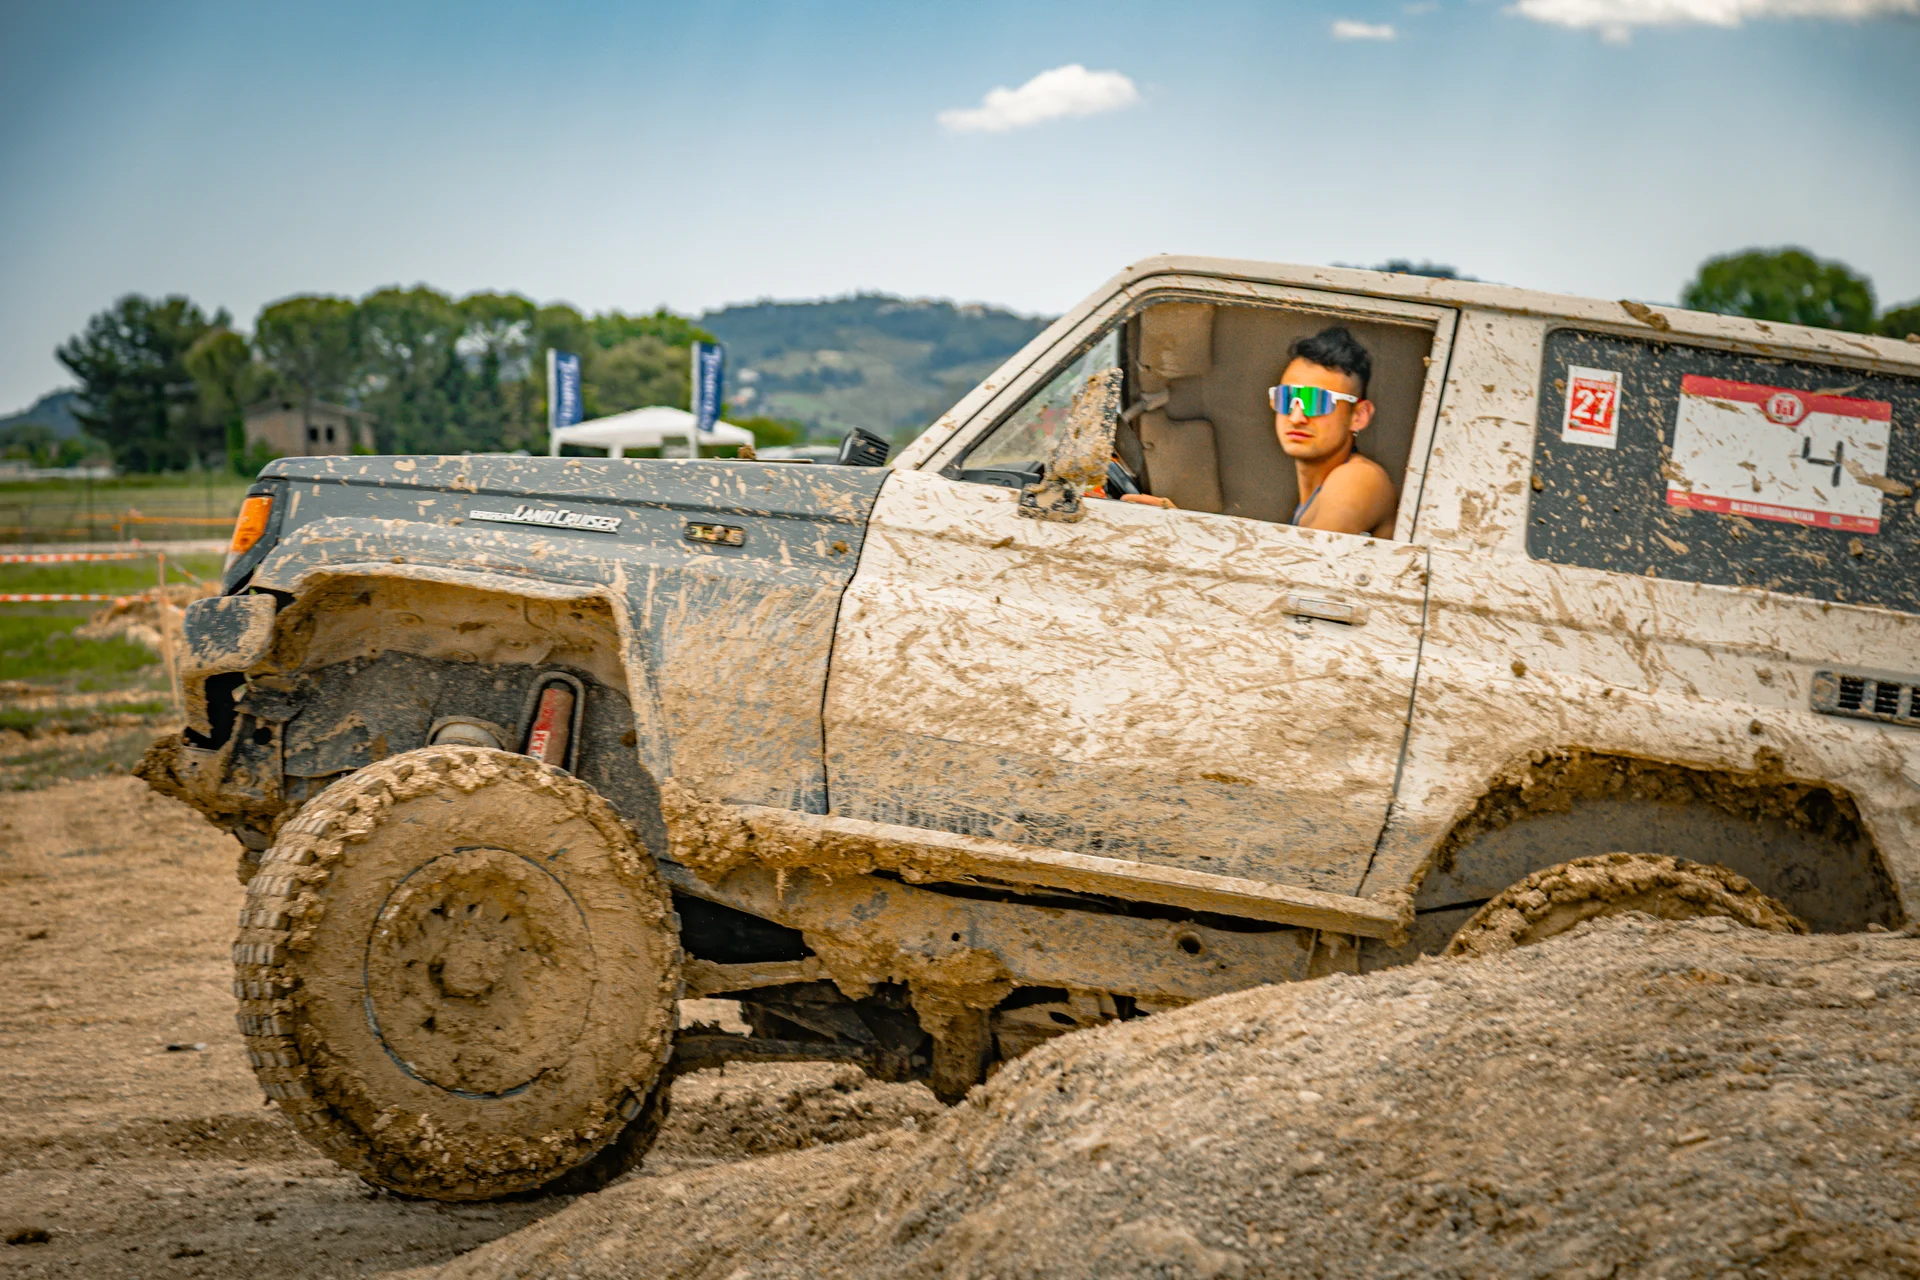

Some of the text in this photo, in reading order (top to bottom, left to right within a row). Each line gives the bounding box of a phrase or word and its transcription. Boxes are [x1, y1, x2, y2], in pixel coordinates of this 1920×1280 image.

[1571, 389, 1613, 423] 27
[1801, 436, 1844, 487] 4
[512, 505, 555, 523] LAND
[554, 509, 622, 531] CRUISER
